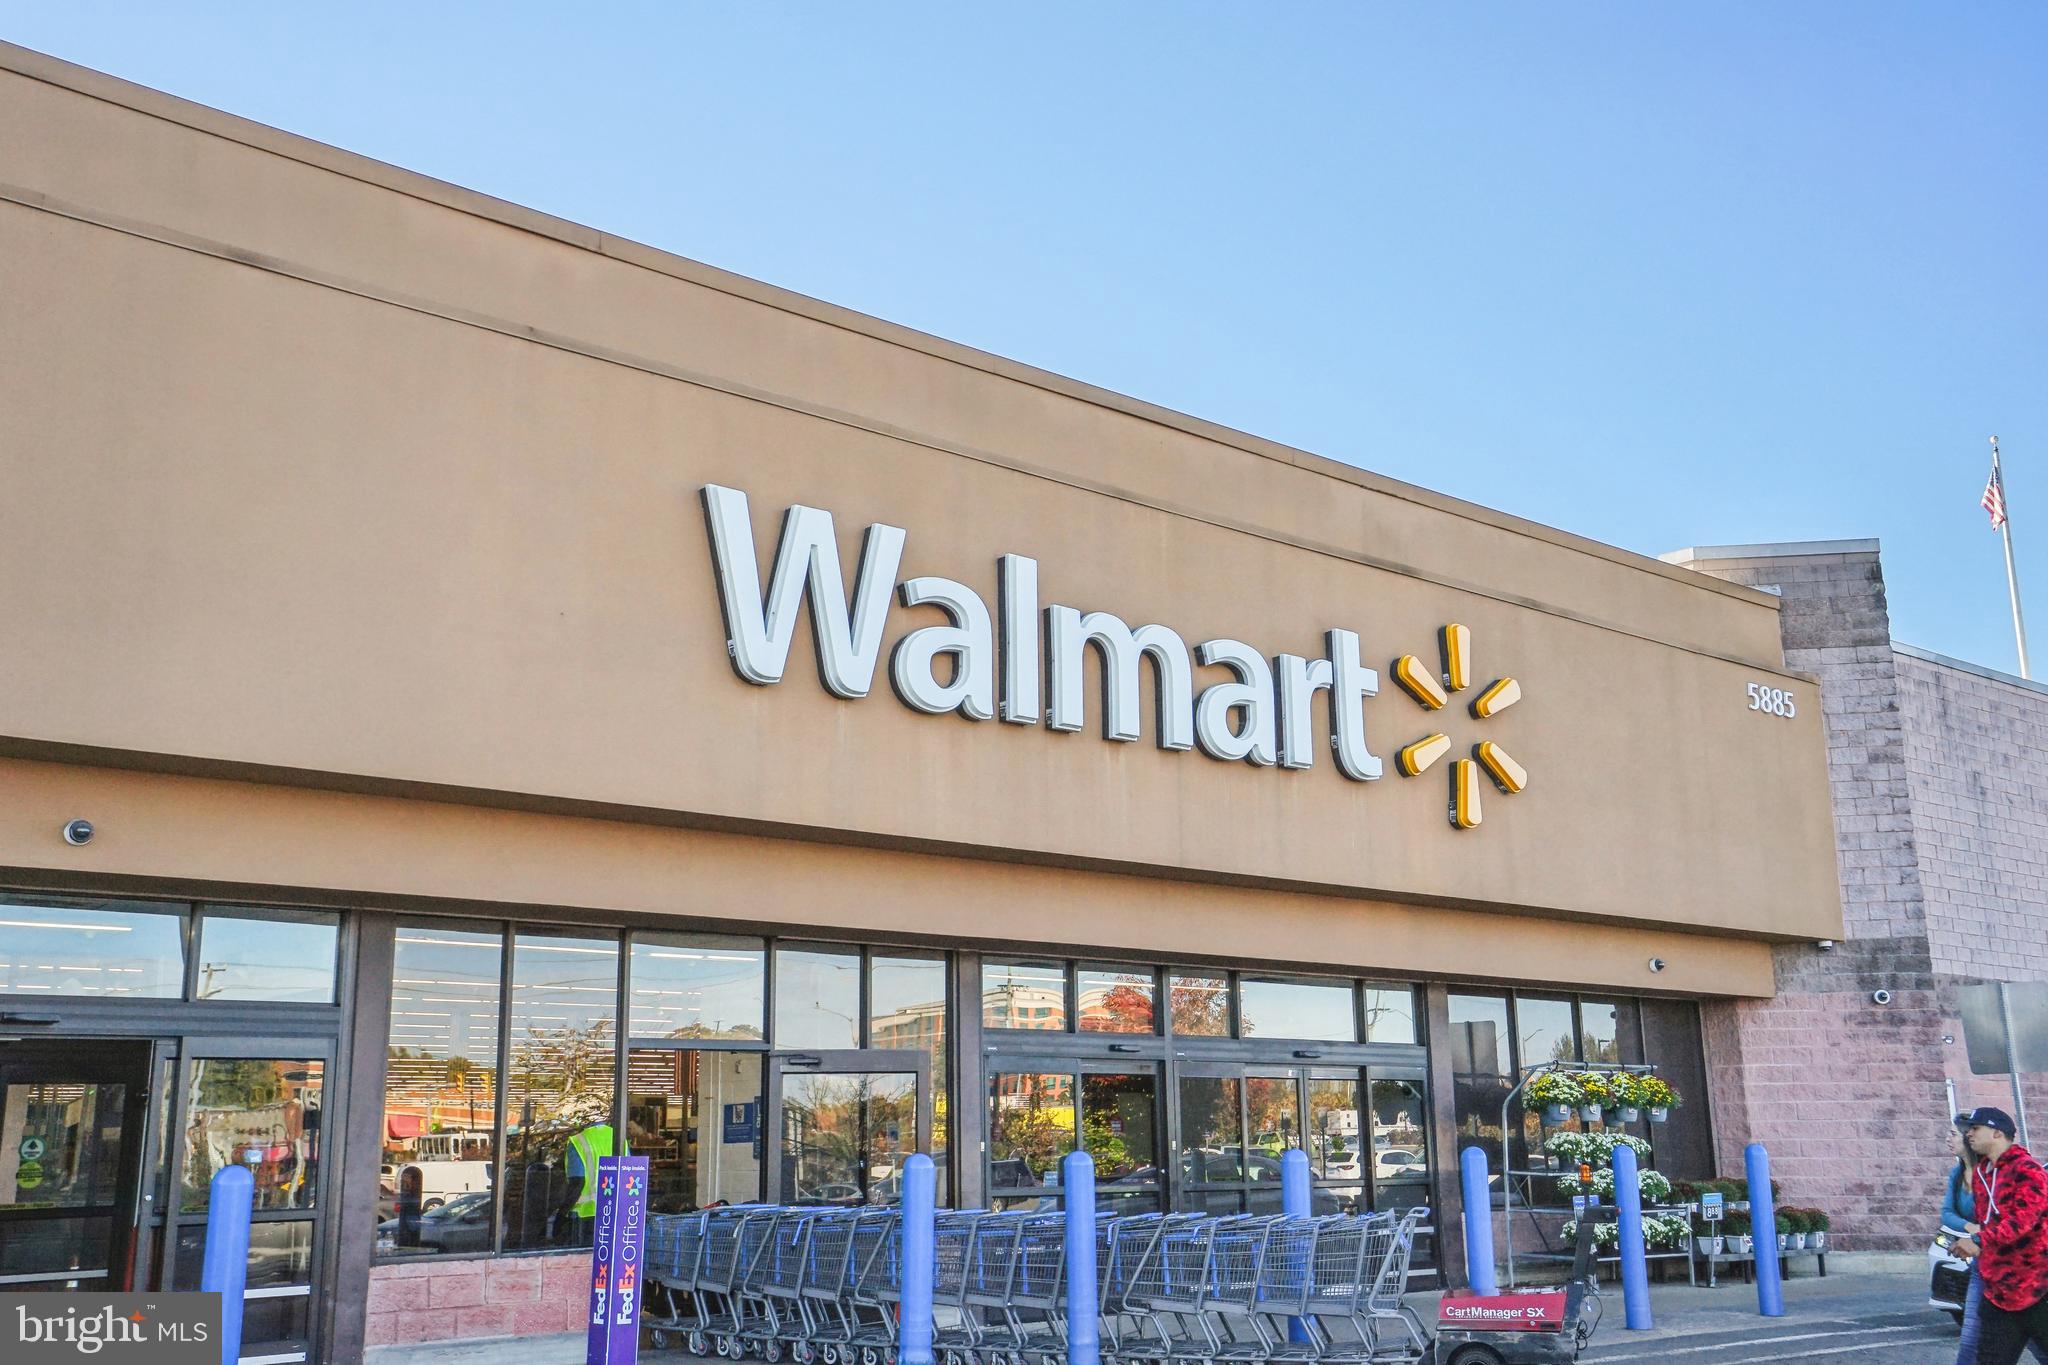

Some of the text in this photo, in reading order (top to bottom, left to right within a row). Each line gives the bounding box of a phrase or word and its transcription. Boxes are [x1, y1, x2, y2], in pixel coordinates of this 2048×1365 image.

[700, 484, 1382, 782] Walmart
[1747, 682, 1795, 718] 5885
[593, 1264, 607, 1325] FedEx
[617, 1264, 635, 1325] FedEx
[1446, 1306, 1545, 1319] CartManager SX
